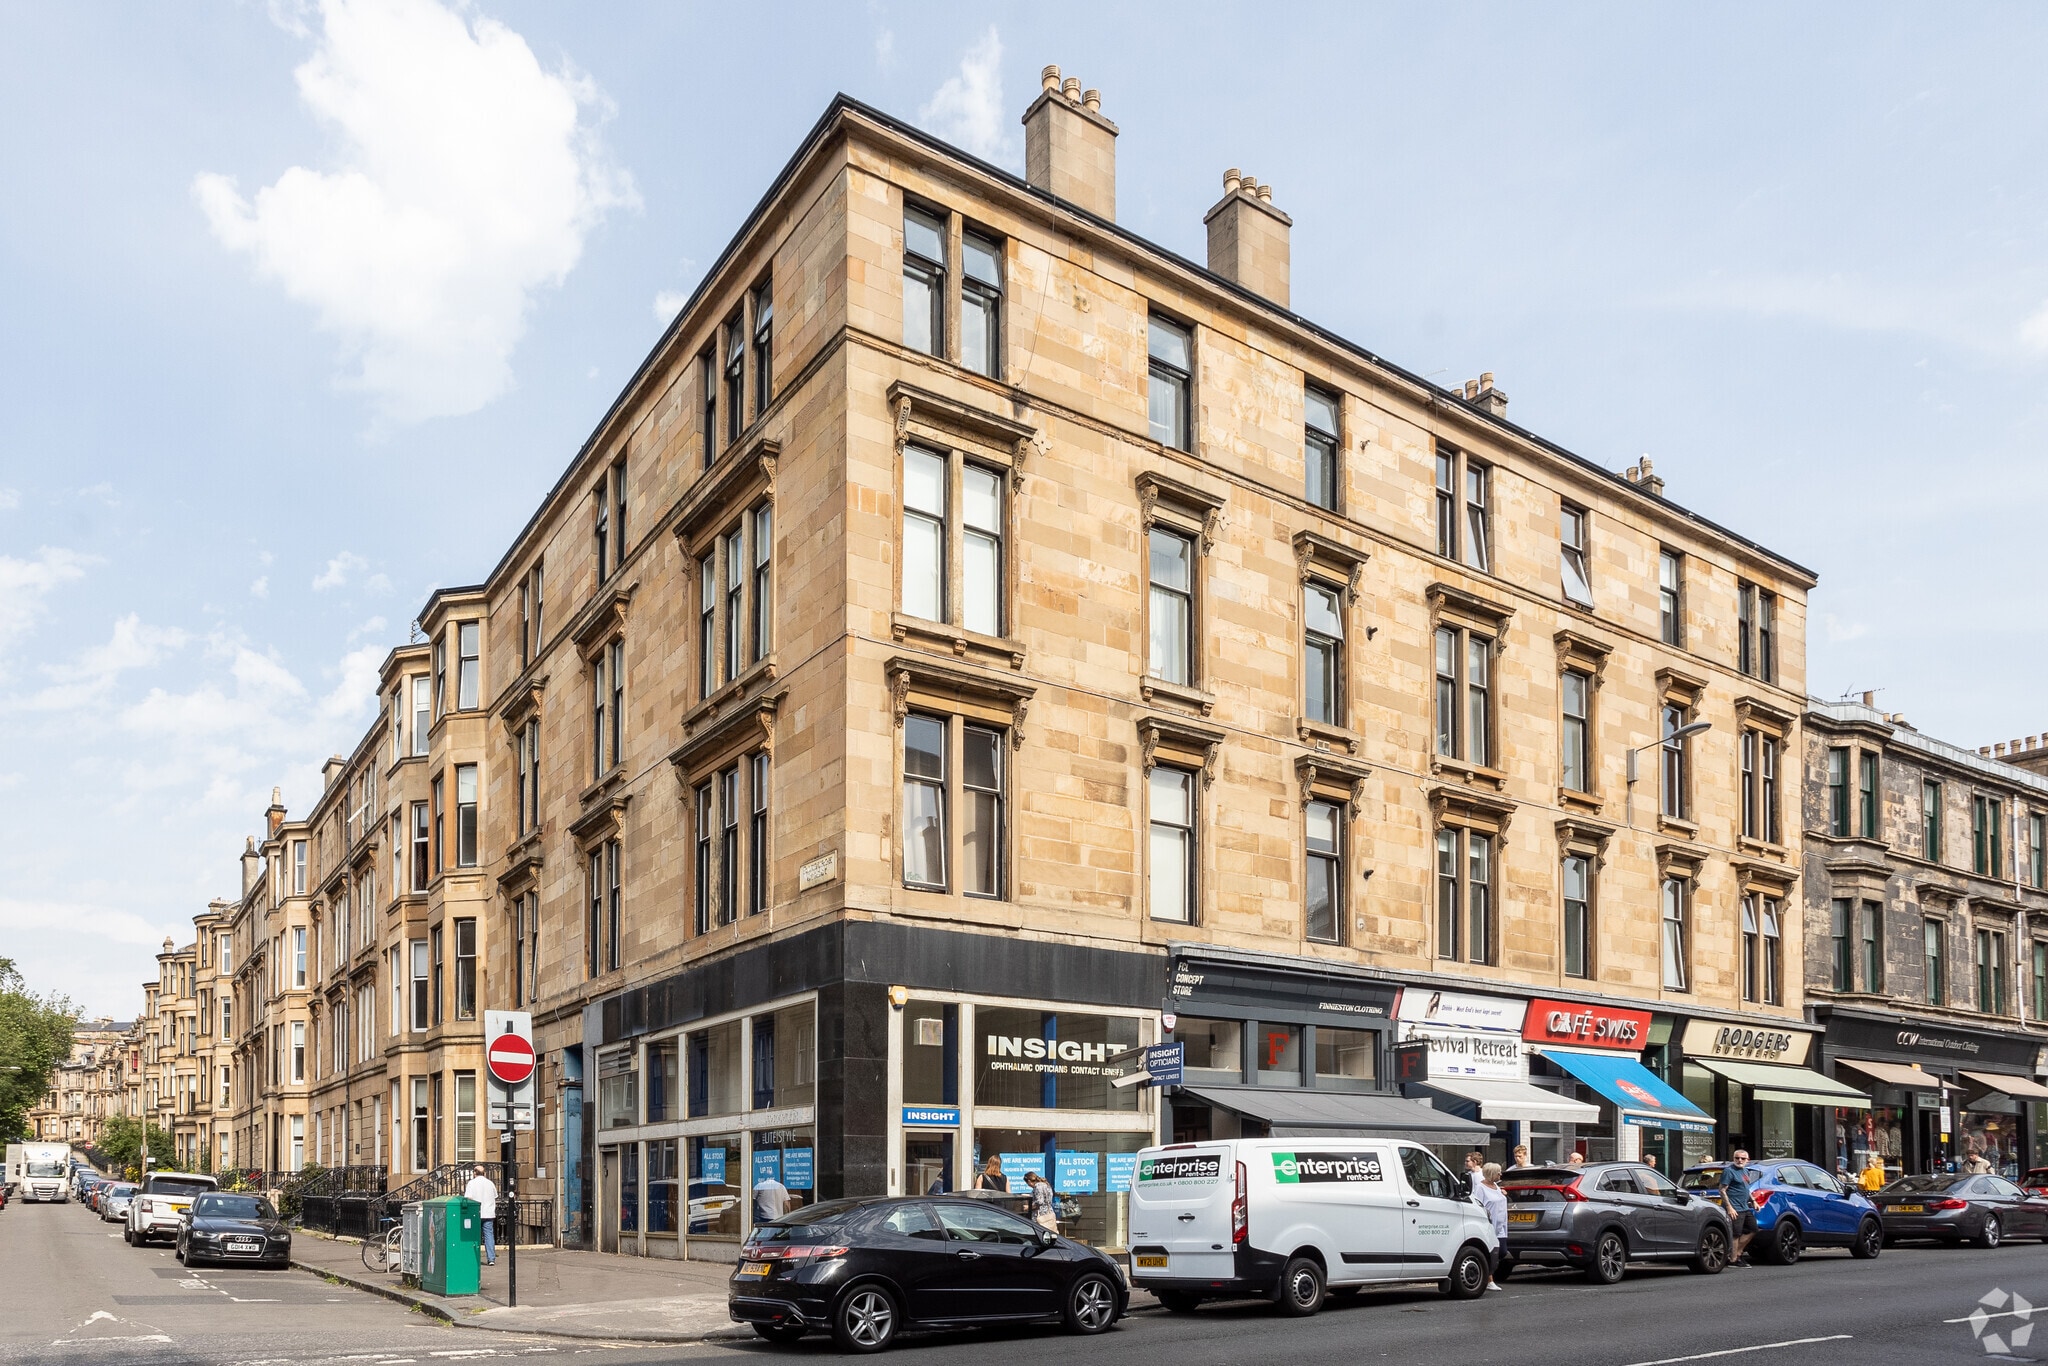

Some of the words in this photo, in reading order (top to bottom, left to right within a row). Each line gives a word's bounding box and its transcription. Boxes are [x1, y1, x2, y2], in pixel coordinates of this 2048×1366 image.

[1178, 962, 1189, 972] FCL
[1175, 973, 1204, 985] CONCEPT
[1172, 985, 1193, 996] STORE
[1319, 1002, 1354, 1012] FINNIESTON
[1354, 1005, 1383, 1014] CLOTHING
[1548, 1010, 1593, 1035] CAFÉ
[1594, 1018, 1639, 1040] SWISS
[1720, 1027, 1791, 1051] RODGERS
[1897, 1031, 1919, 1045] CCW
[988, 1035, 1127, 1062] INSIGHT
[1150, 1048, 1180, 1059] INSIGHT
[1267, 1032, 1289, 1065] F
[1473, 1038, 1518, 1058] Retreat
[1715, 1046, 1776, 1059] BUTCHERS
[991, 1061, 1033, 1072] OPHTHALMIC
[1035, 1064, 1068, 1073] OPTICIANS
[1071, 1067, 1100, 1076] CONTACT
[1102, 1067, 1124, 1076] LENSES
[1150, 1057, 1180, 1067] OPTICIANS
[1401, 1052, 1420, 1077] F
[907, 1112, 955, 1120] INSIGHT
[1142, 1158, 1219, 1176] enterprise
[1278, 1156, 1380, 1178] enterprise
